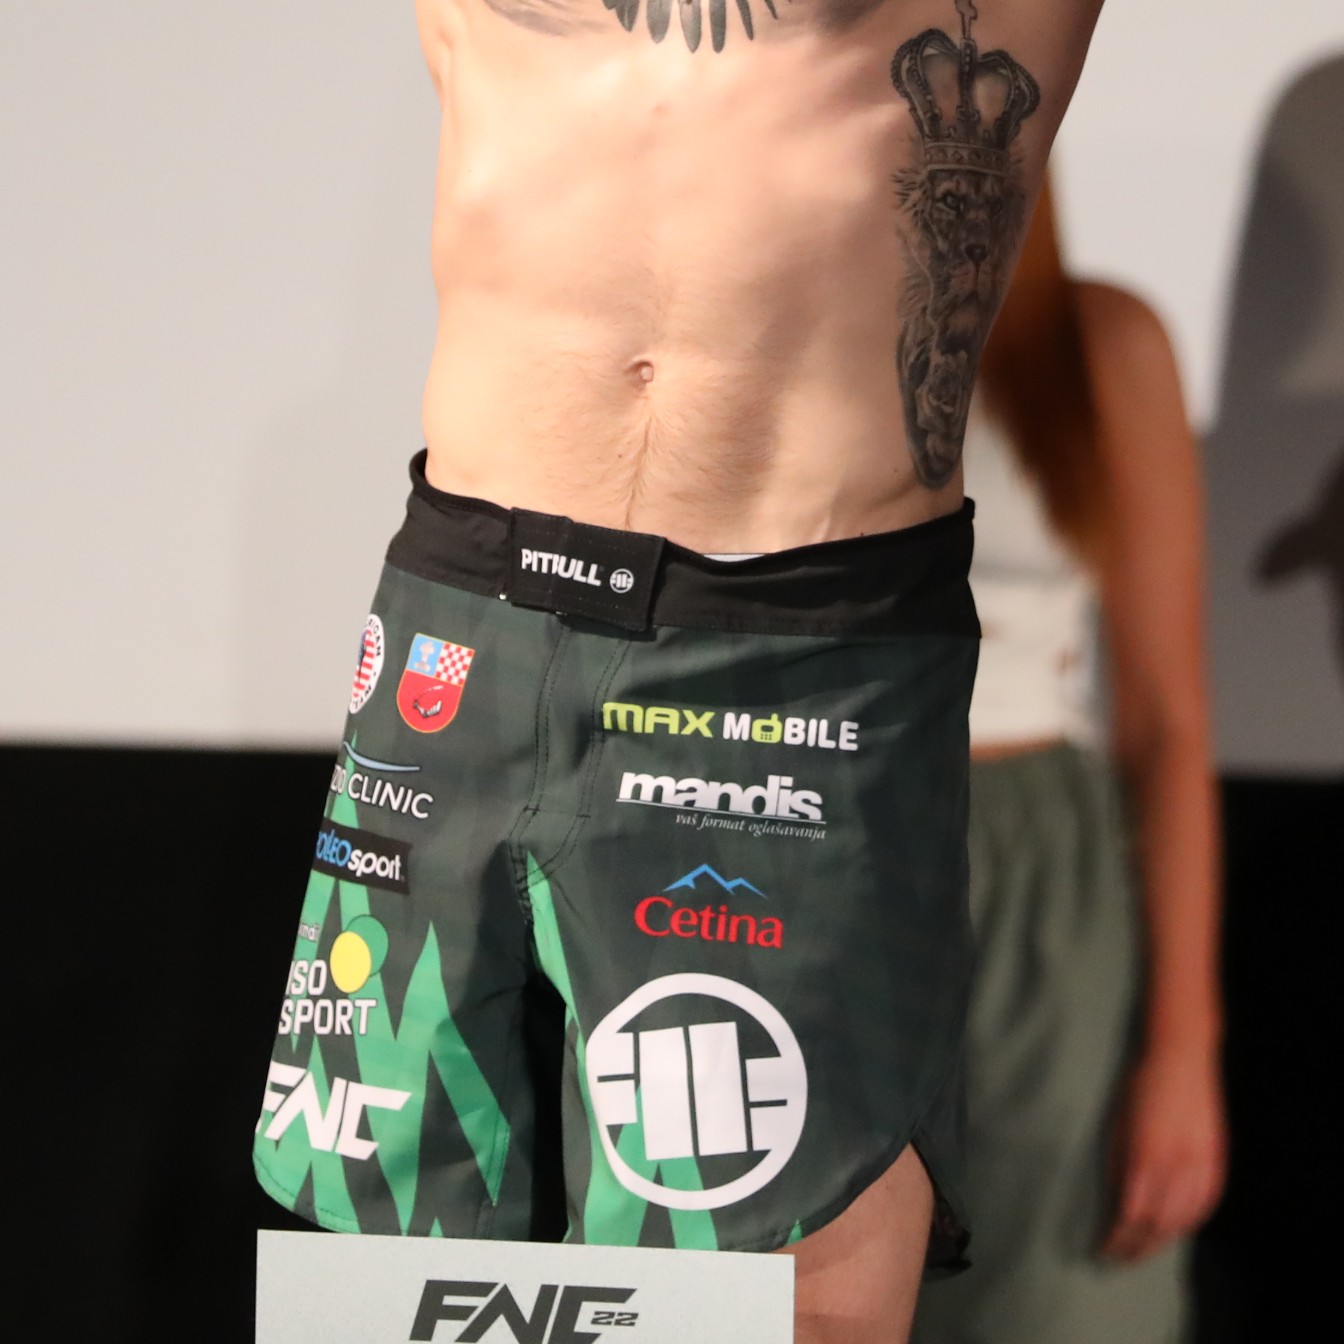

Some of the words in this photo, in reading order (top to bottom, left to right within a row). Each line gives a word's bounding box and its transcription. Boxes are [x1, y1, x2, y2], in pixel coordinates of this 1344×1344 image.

[722, 712, 859, 751] MOBILE
[348, 773, 433, 819] CLINIC
[618, 772, 823, 821] mandis
[697, 814, 745, 831] format
[634, 895, 783, 949] Cetina
[277, 999, 377, 1035] SPORT
[256, 1060, 412, 1161] FNC
[409, 1279, 638, 1344] FNC
[590, 1311, 639, 1327] 22
